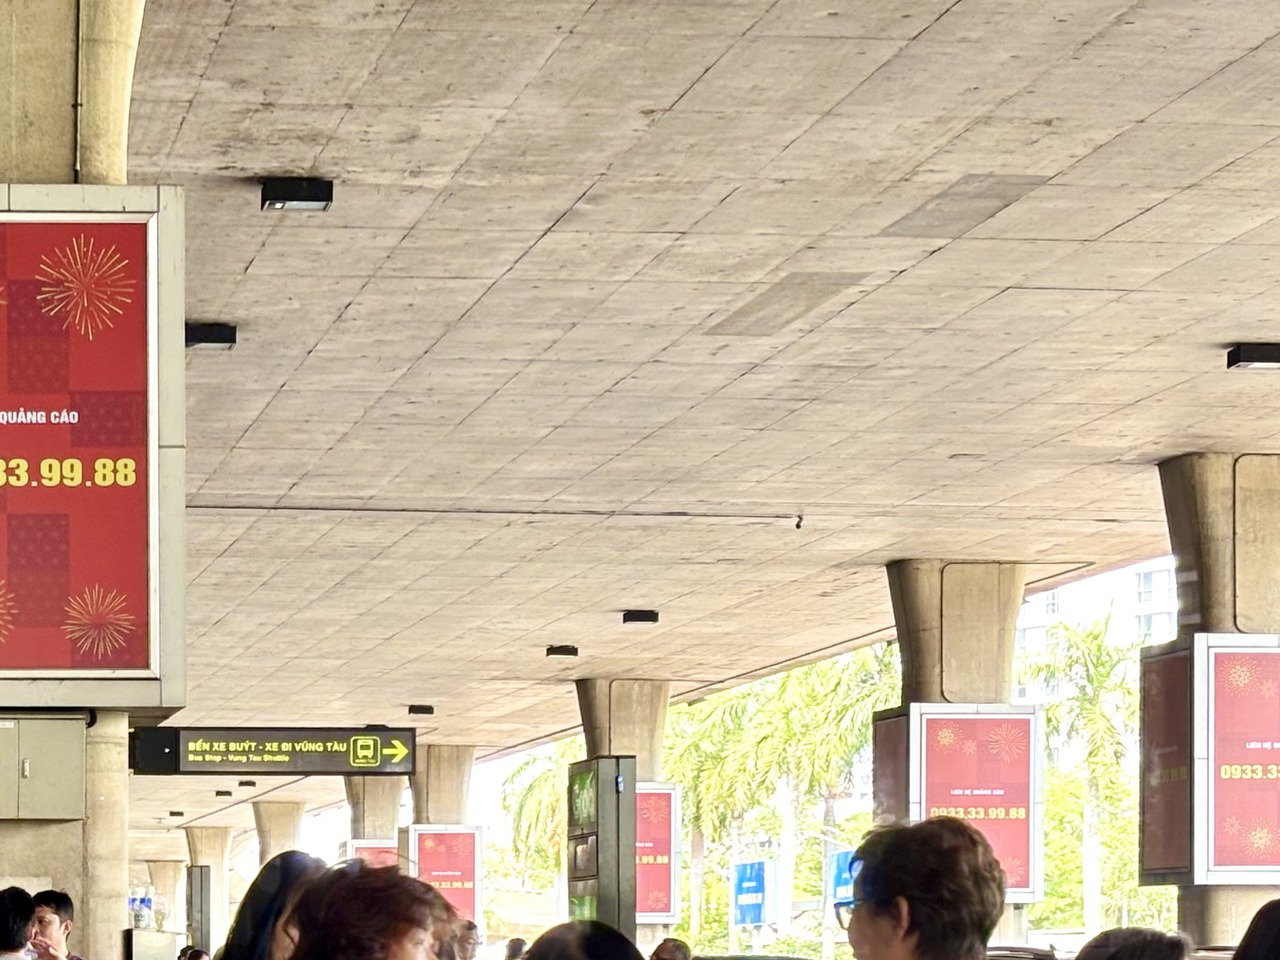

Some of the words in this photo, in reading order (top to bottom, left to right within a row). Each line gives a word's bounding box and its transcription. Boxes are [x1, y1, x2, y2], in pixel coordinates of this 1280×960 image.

[50, 409, 79, 424] CÁO
[212, 742, 227, 752] XE
[265, 742, 280, 752] XE
[294, 740, 324, 752] VŨNG
[326, 741, 347, 752] TÀU
[188, 754, 203, 762] Bus
[228, 754, 247, 763] Vung
[1220, 764, 1280, 779] 0933.3
